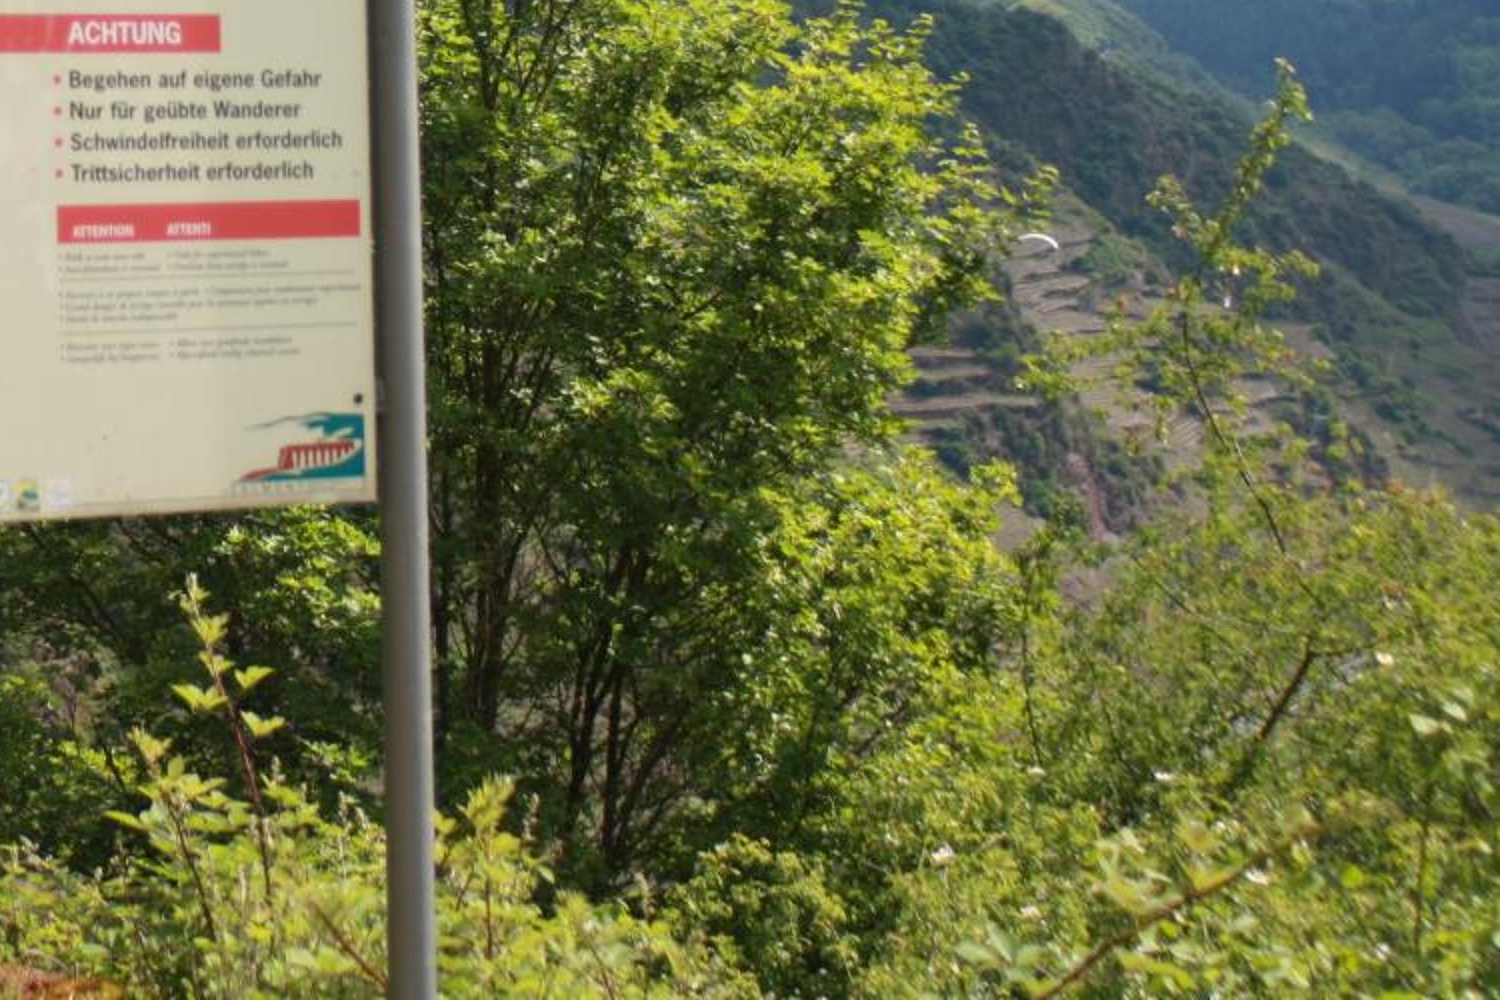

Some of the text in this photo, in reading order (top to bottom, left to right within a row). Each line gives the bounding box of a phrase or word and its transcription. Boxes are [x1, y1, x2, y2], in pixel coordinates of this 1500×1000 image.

[68, 21, 181, 45] ACHTUNG
[68, 69, 322, 91] Begehen auf eigene Gefahr
[69, 100, 301, 123] Nur für geübte Wanderer
[70, 129, 343, 152] Schwindelfreiheit erforderlich
[72, 160, 314, 182] Trittsicherheit erforderlich
